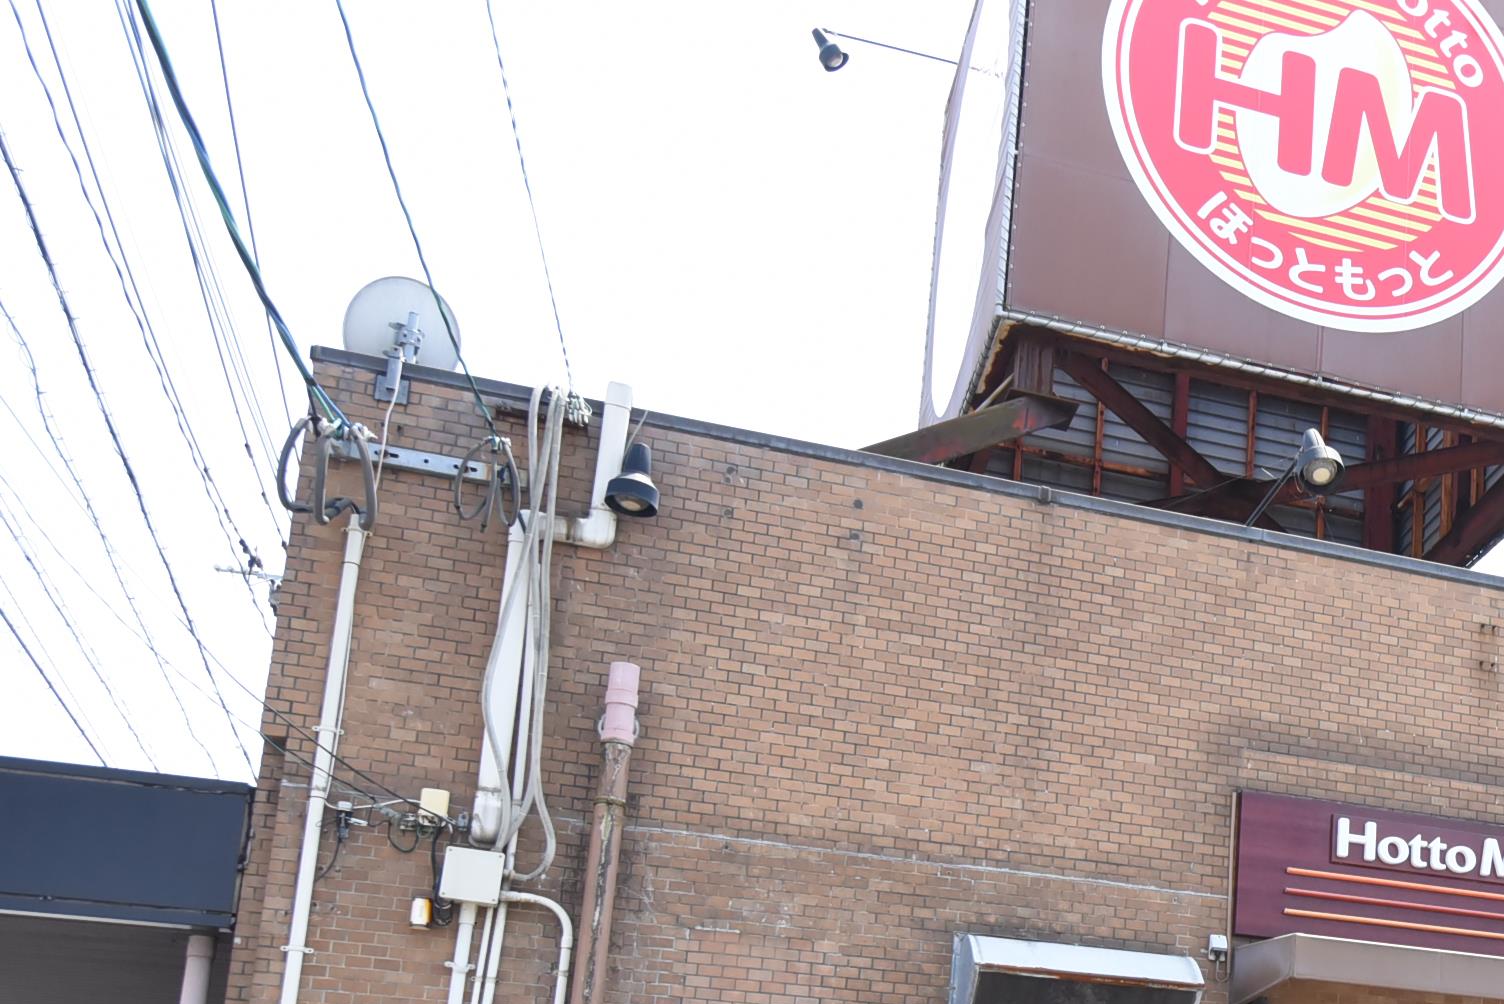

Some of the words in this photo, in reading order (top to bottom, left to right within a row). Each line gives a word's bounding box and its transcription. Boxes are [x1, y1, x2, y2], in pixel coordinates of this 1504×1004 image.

[1173, 17, 1476, 225] HM
[1197, 190, 1454, 301] ほっともっと
